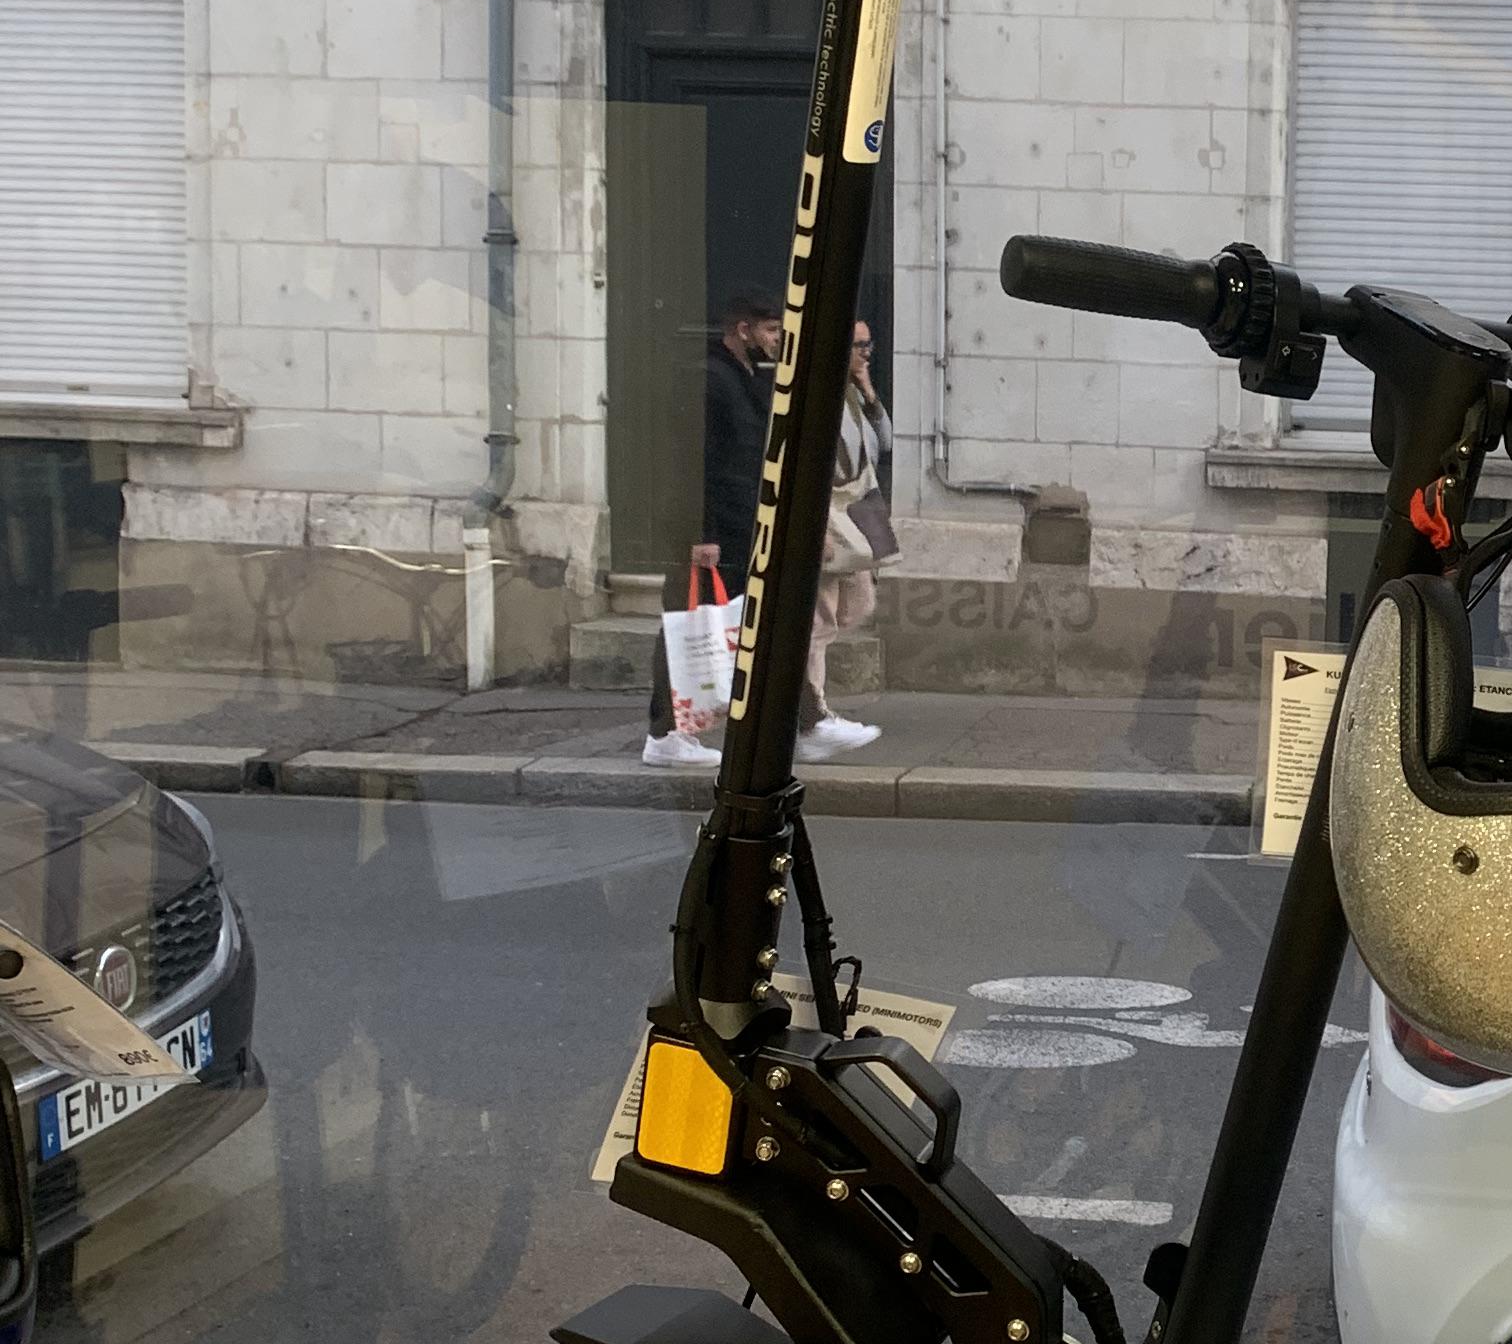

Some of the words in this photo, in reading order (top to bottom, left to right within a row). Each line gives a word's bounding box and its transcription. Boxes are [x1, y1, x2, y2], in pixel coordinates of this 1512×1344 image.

[810, 44, 833, 137] technology
[872, 1005, 943, 1028] (MINIMOTORS)
[118, 1049, 158, 1066] 890€
[47, 1133, 54, 1148] F
